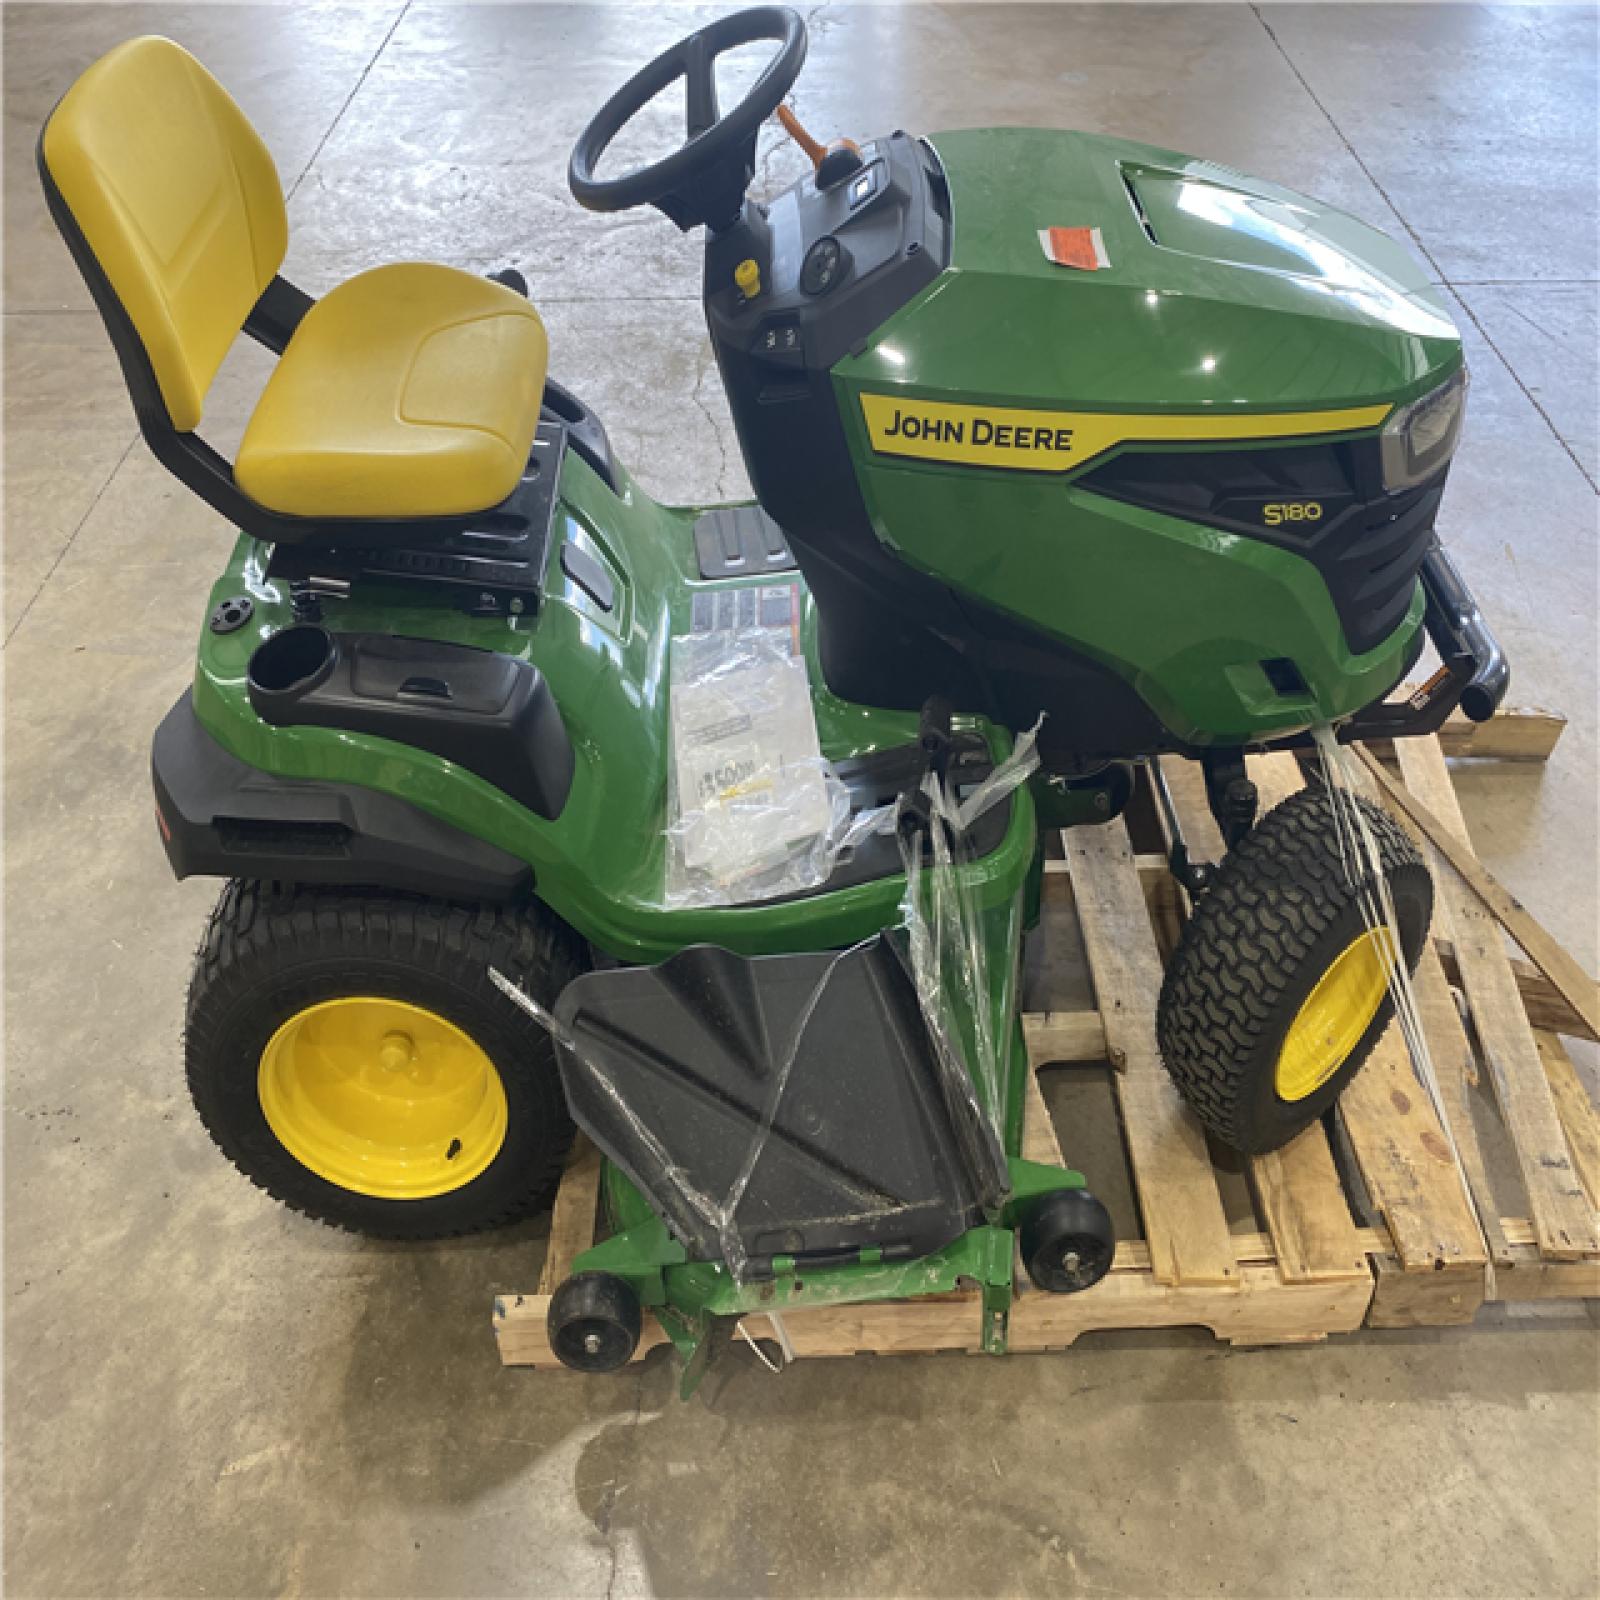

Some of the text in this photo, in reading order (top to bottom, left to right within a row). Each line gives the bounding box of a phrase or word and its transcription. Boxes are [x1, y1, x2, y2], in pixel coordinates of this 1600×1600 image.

[884, 410, 1073, 451] JOHN DEERE
[1263, 502, 1322, 526] S180
